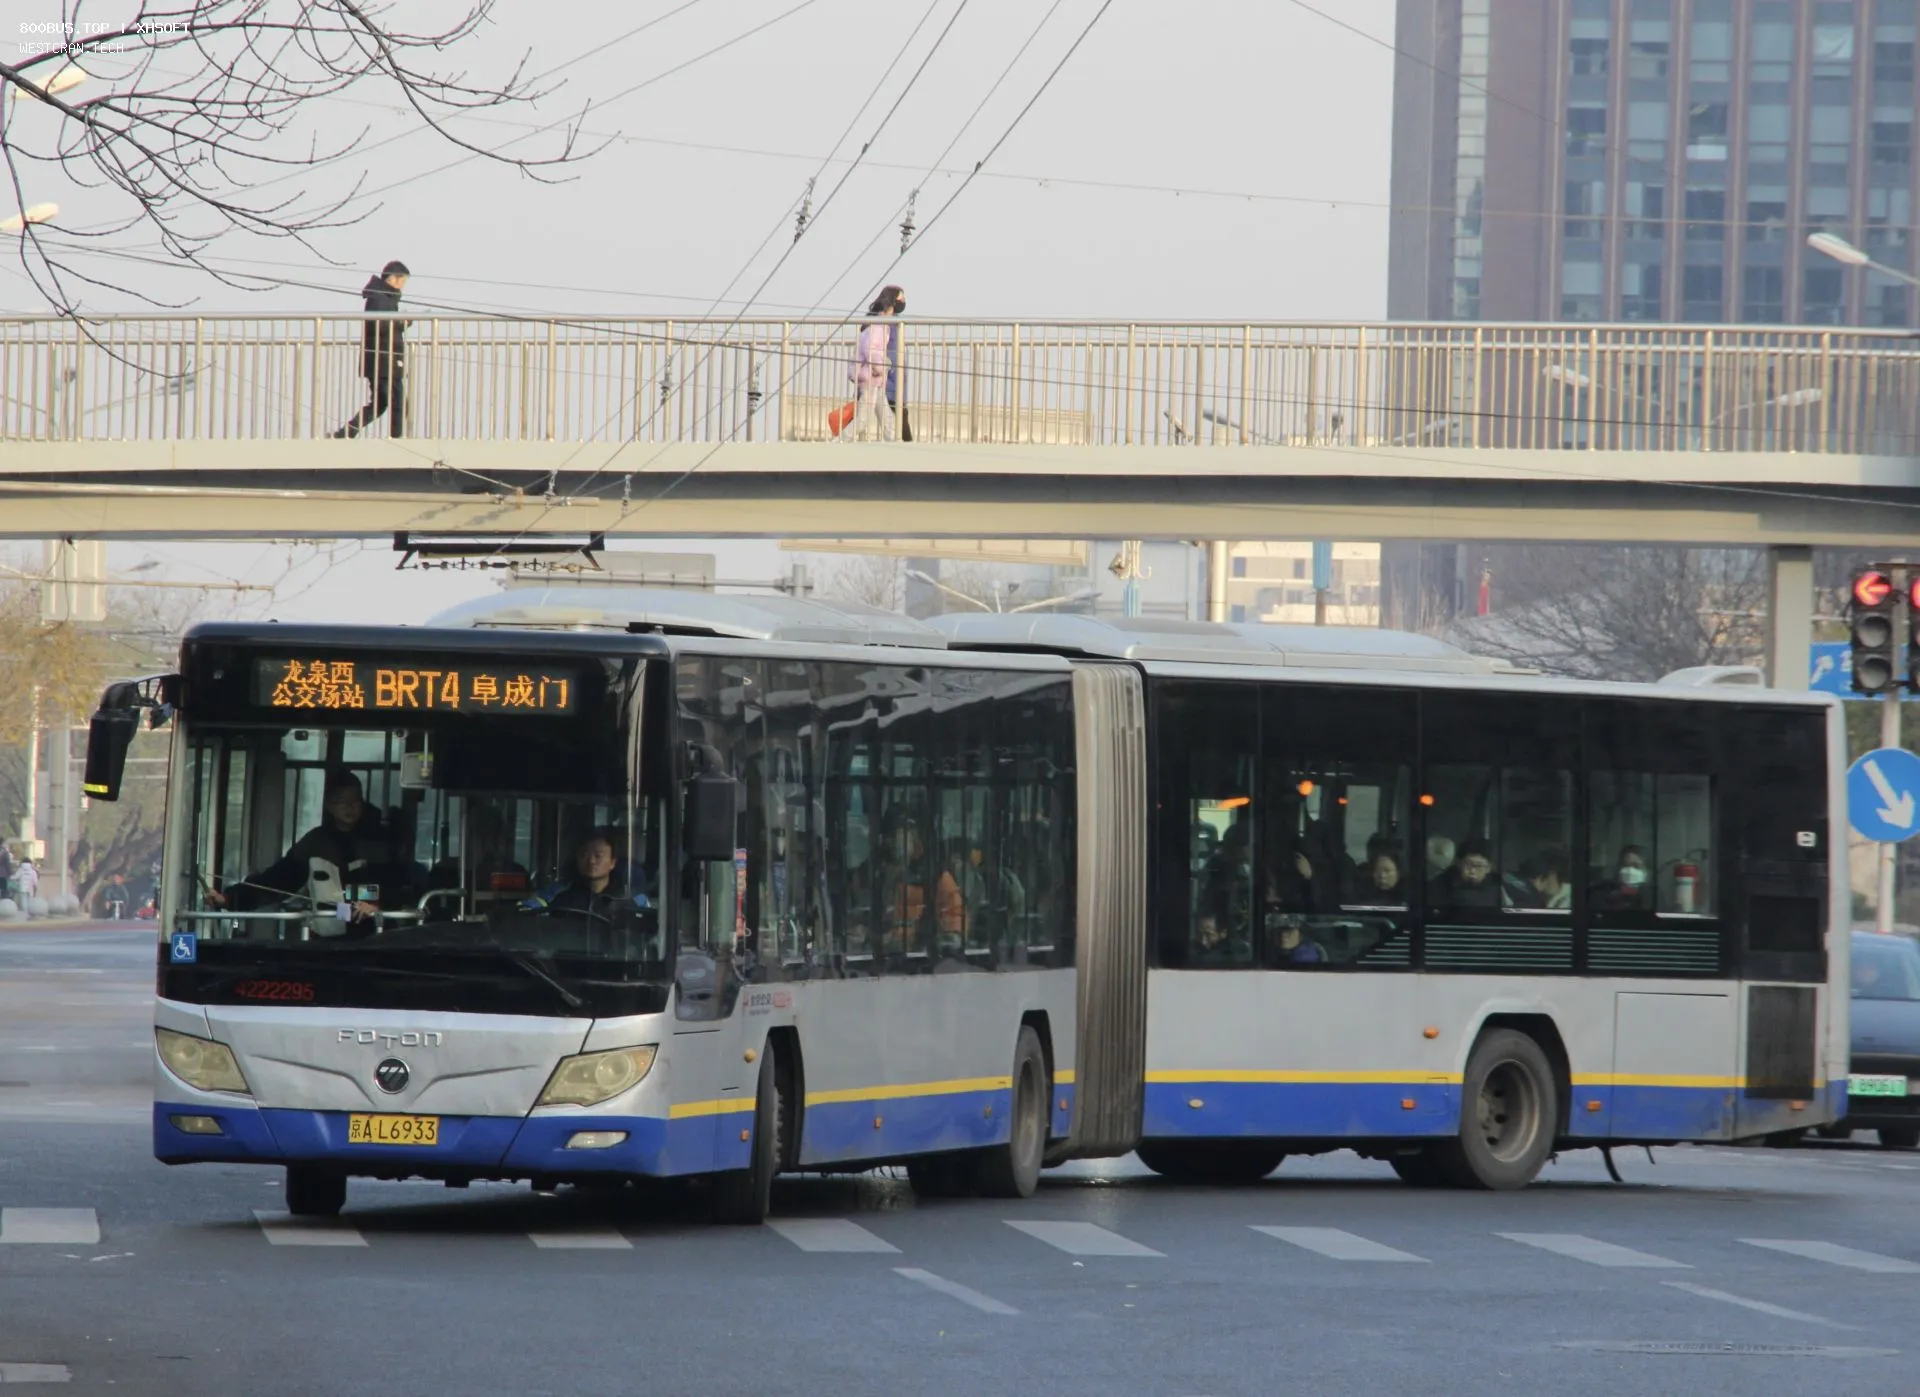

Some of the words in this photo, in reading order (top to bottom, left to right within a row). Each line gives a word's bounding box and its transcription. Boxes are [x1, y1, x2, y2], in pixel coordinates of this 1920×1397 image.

[283, 659, 354, 684] 龙泉西
[272, 683, 364, 708] 公交场站
[376, 669, 460, 709] BRT4
[469, 674, 568, 709] 阜成门
[337, 1028, 442, 1050] FOTON
